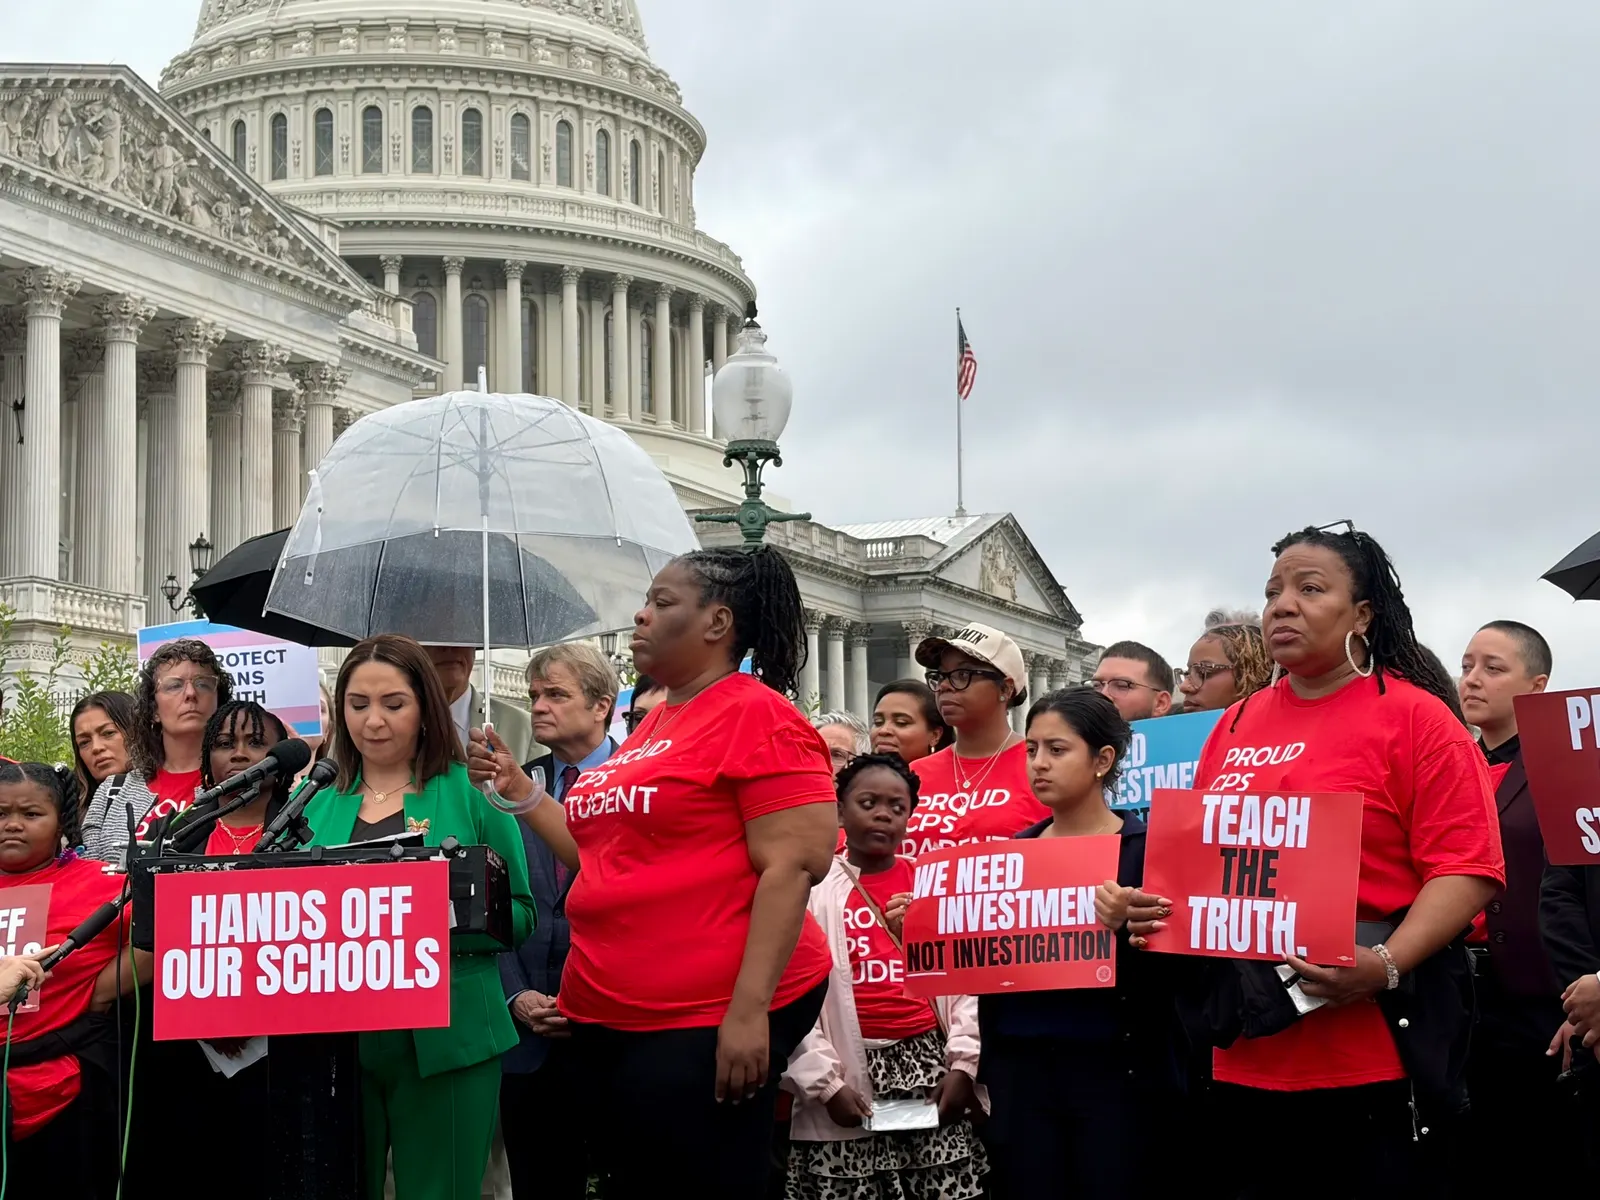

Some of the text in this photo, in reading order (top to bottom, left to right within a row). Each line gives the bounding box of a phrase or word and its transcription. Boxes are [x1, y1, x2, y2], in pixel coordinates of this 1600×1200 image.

[214, 649, 287, 667] ROTECT
[229, 670, 265, 687] ANS
[1221, 742, 1306, 771] PROUD
[572, 769, 617, 789] CPS
[1104, 760, 1200, 807] ESTME
[1209, 772, 1256, 792] CPS
[564, 785, 659, 822] TUDENT
[917, 788, 1011, 816] PROUD
[1202, 794, 1312, 849] TEACH
[905, 812, 958, 834] CPS
[913, 852, 1025, 900] WE NEED
[1220, 847, 1279, 898] THE
[190, 886, 413, 945] HANDS OFF
[937, 885, 1105, 935] INVESTMEN
[1188, 895, 1308, 957] TRUTH.
[846, 935, 870, 957] PS
[906, 929, 1112, 973] NOT INVESTIGATION
[162, 937, 440, 1000] OUR SCHOOLS
